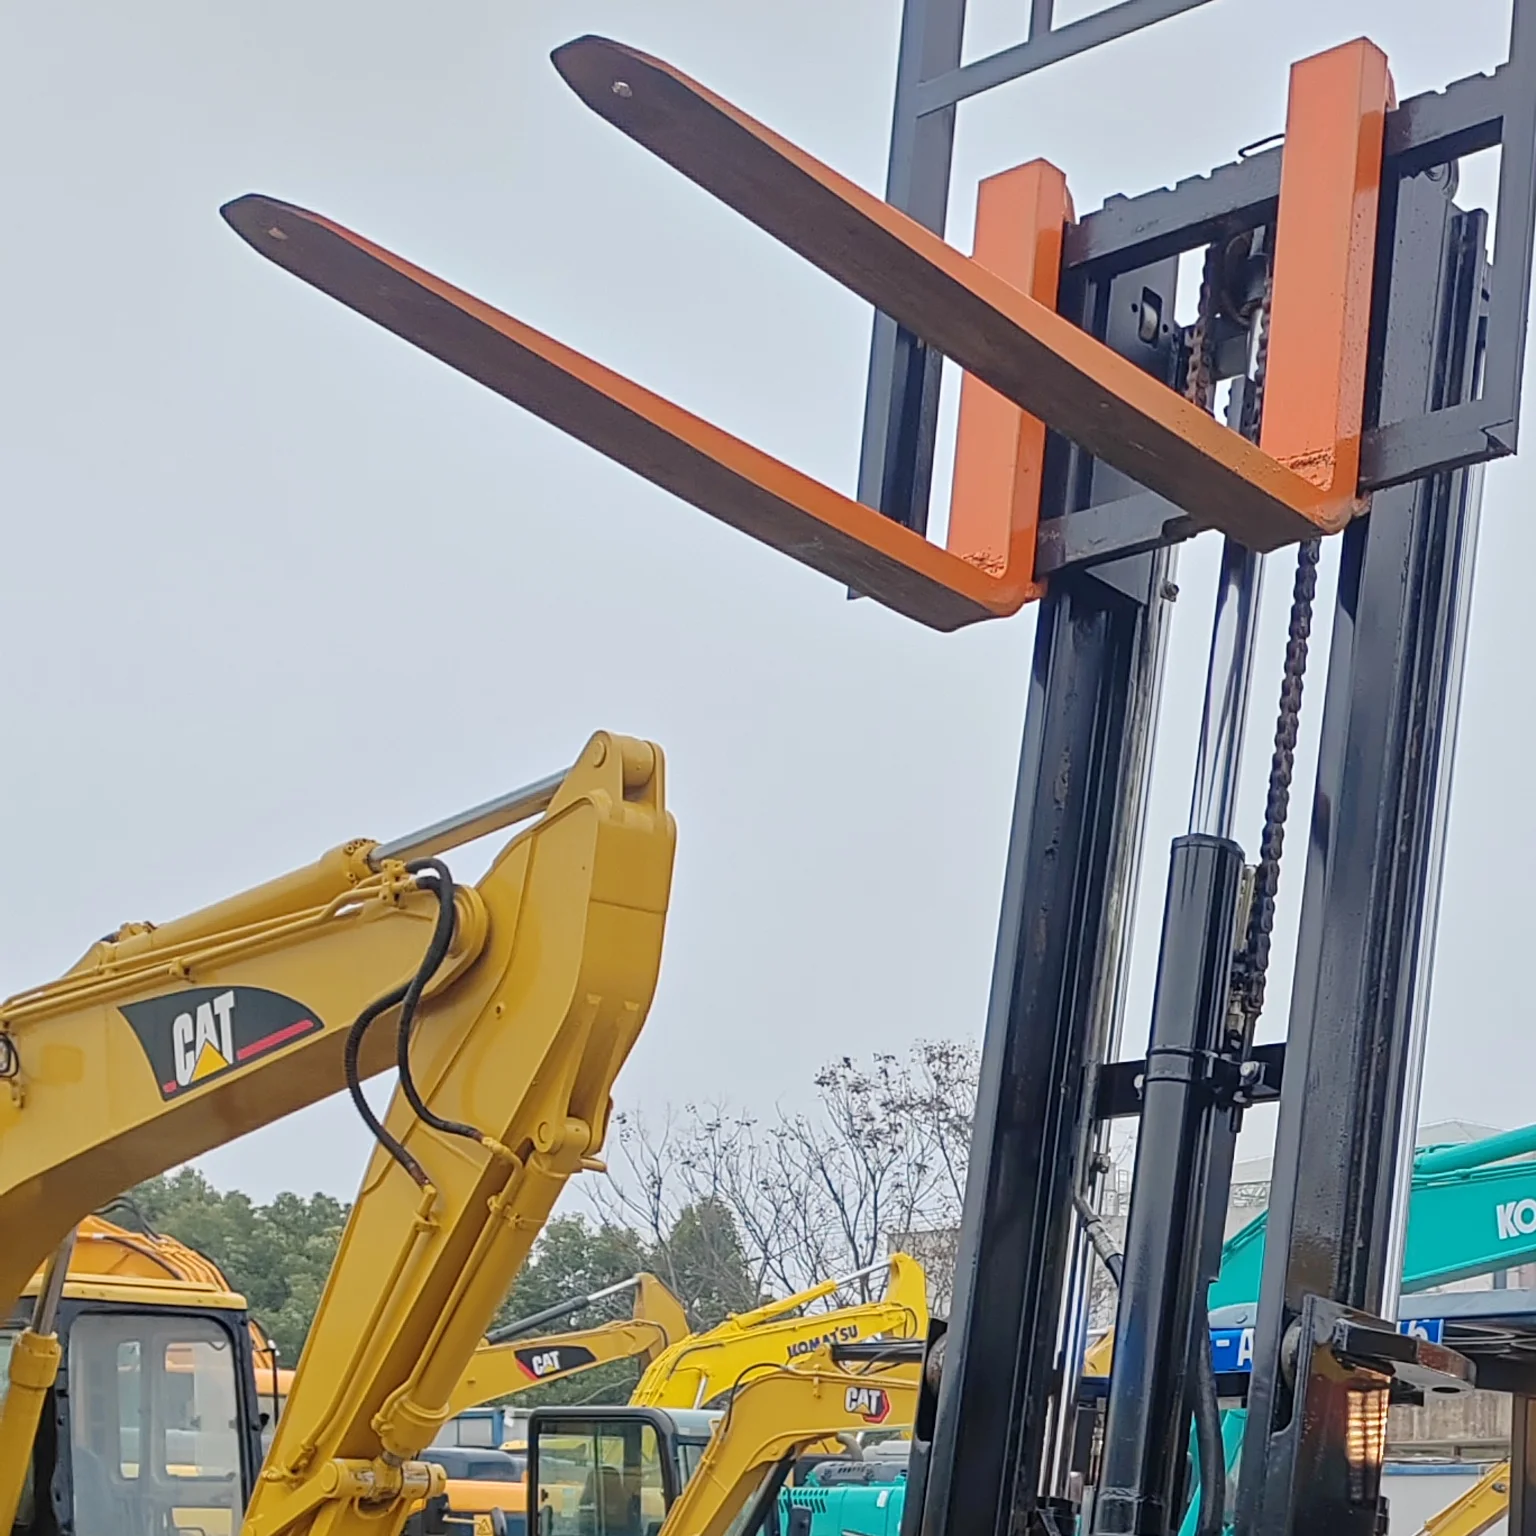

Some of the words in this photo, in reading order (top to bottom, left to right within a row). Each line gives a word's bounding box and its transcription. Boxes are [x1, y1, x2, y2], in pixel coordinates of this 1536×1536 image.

[173, 990, 235, 1086] CAT
[532, 1350, 560, 1376] CAT
[845, 1386, 881, 1415] CAT
